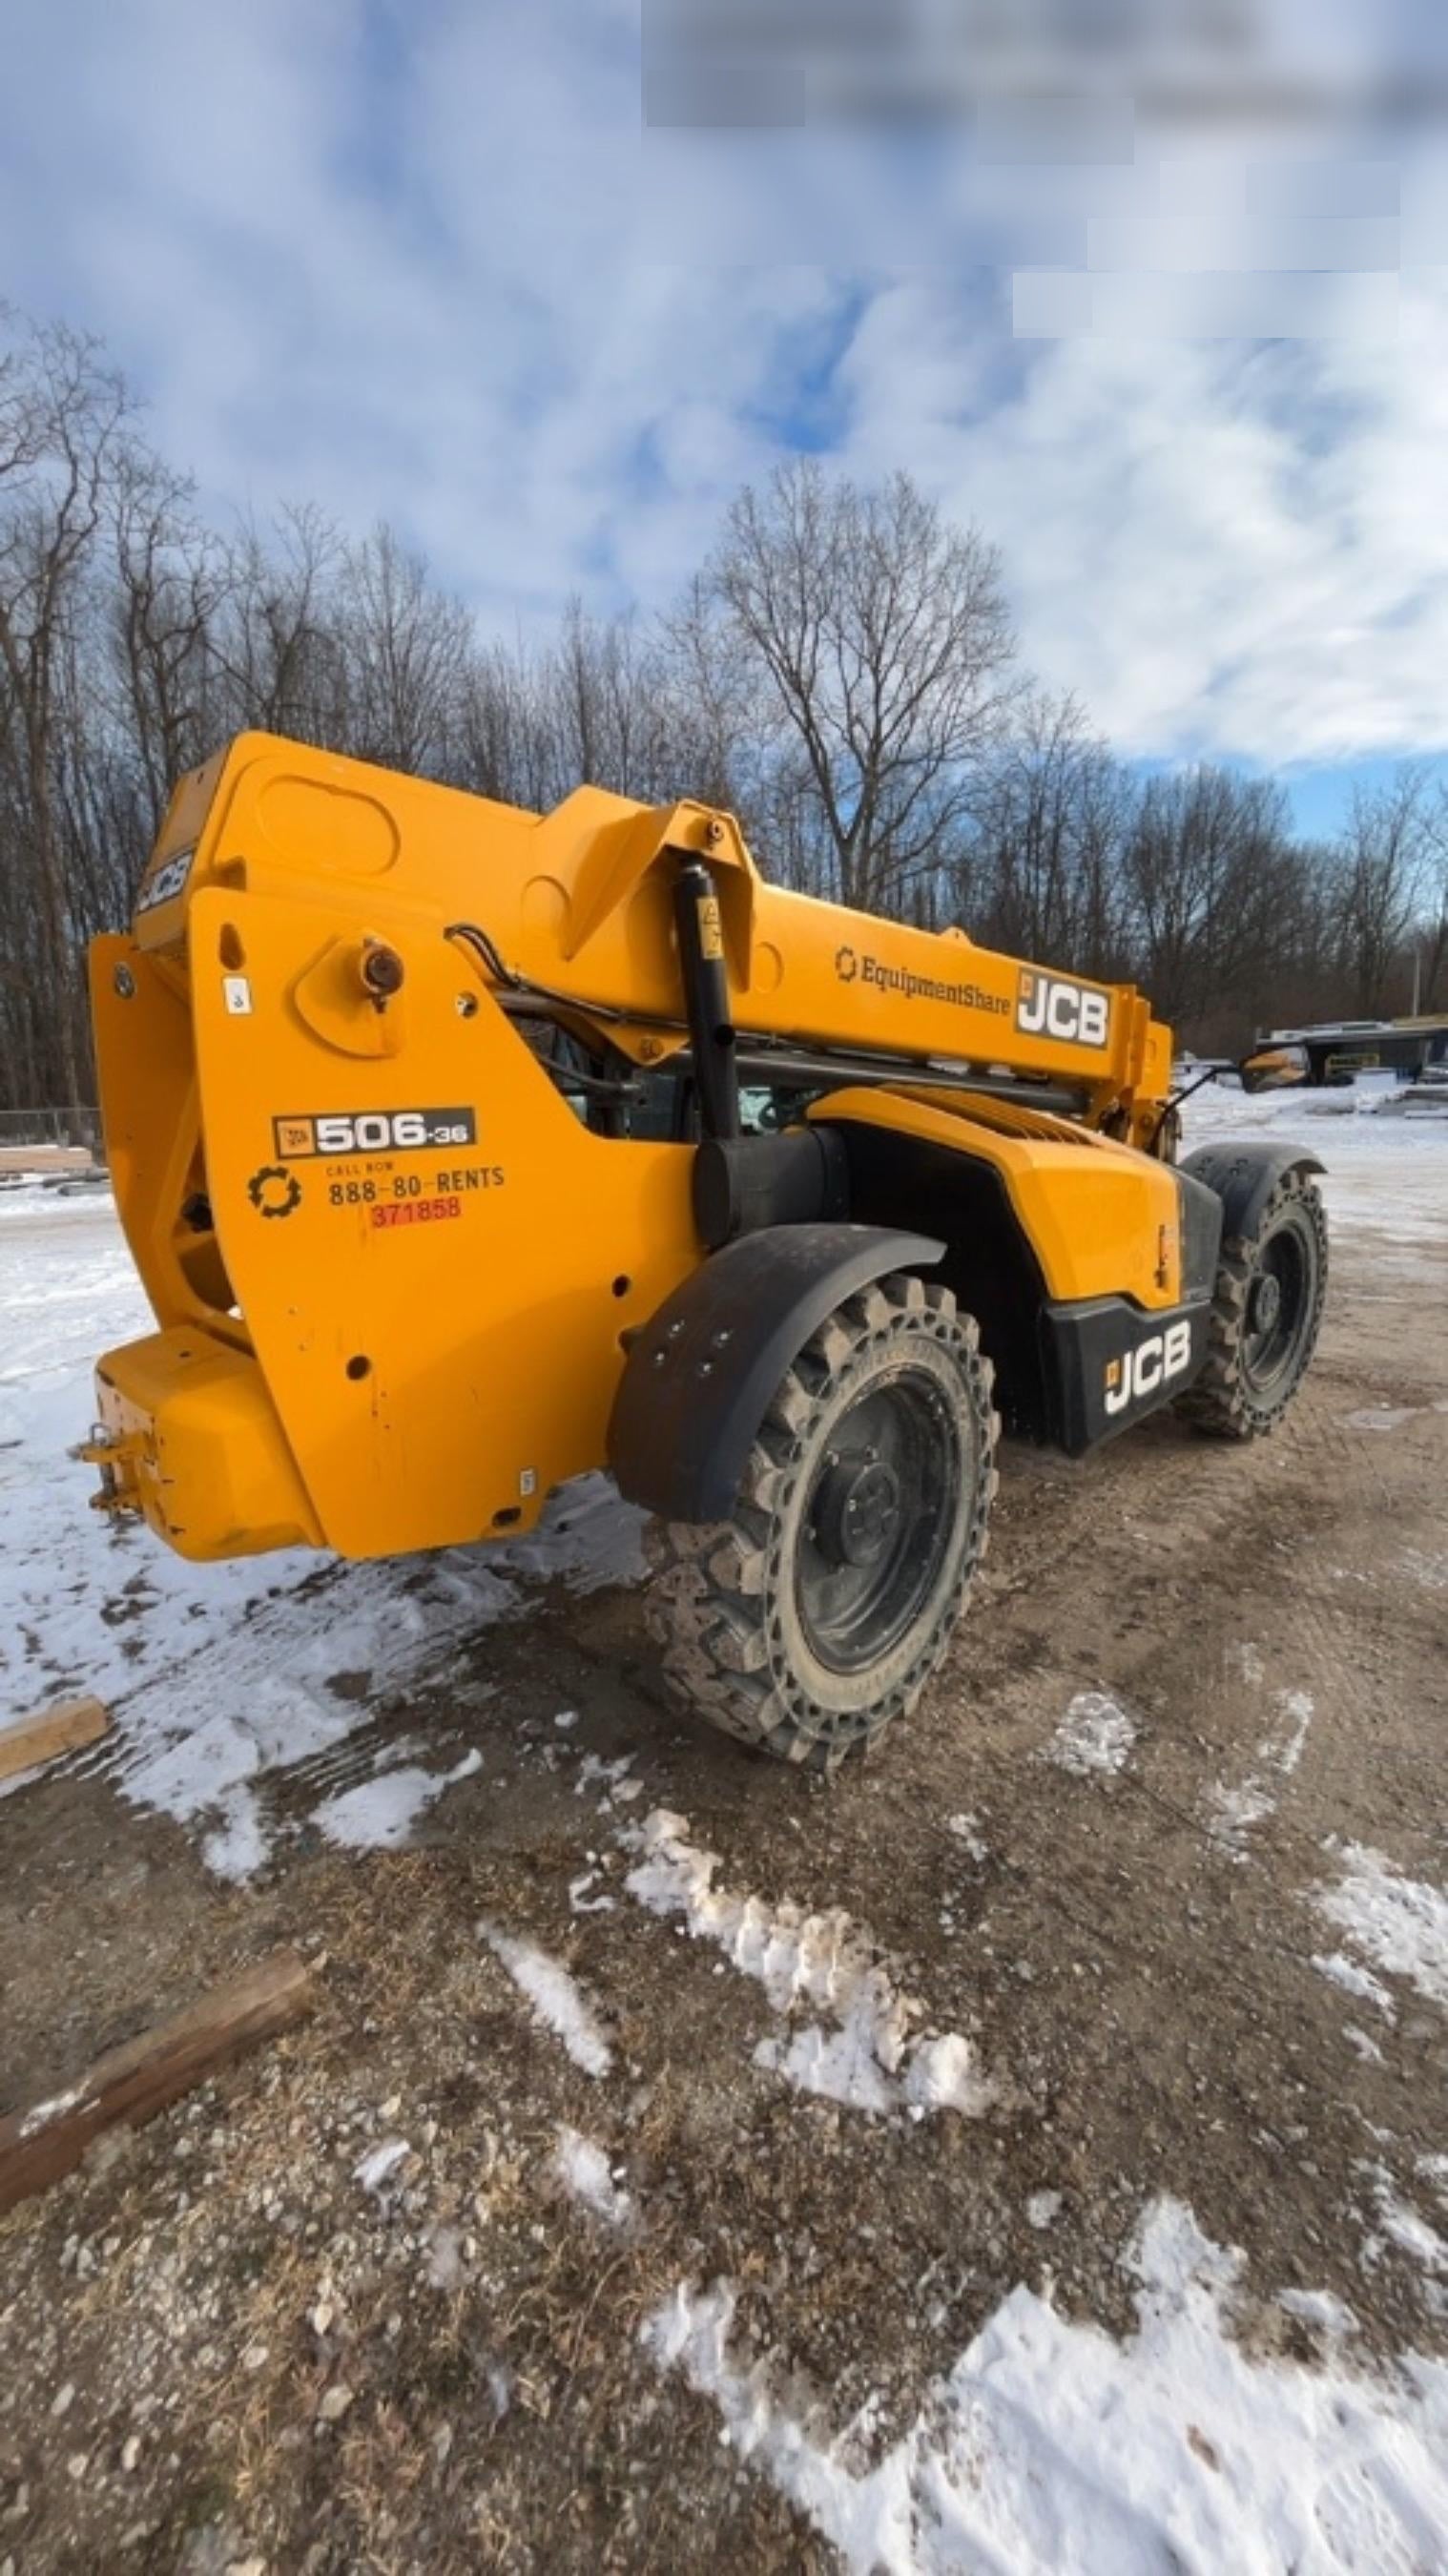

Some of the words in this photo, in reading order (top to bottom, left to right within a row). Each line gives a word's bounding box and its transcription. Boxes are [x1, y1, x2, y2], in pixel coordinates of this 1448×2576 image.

[138, 853, 193, 910] JCB
[860, 955, 1011, 1016] EquipmentShare
[1017, 977, 1109, 1046] JCB
[316, 1112, 468, 1153] 506-36
[326, 1164, 360, 1177] CALL
[366, 1160, 394, 1174] NOW
[371, 1195, 462, 1229] 371858
[1104, 1319, 1191, 1416] JCB
